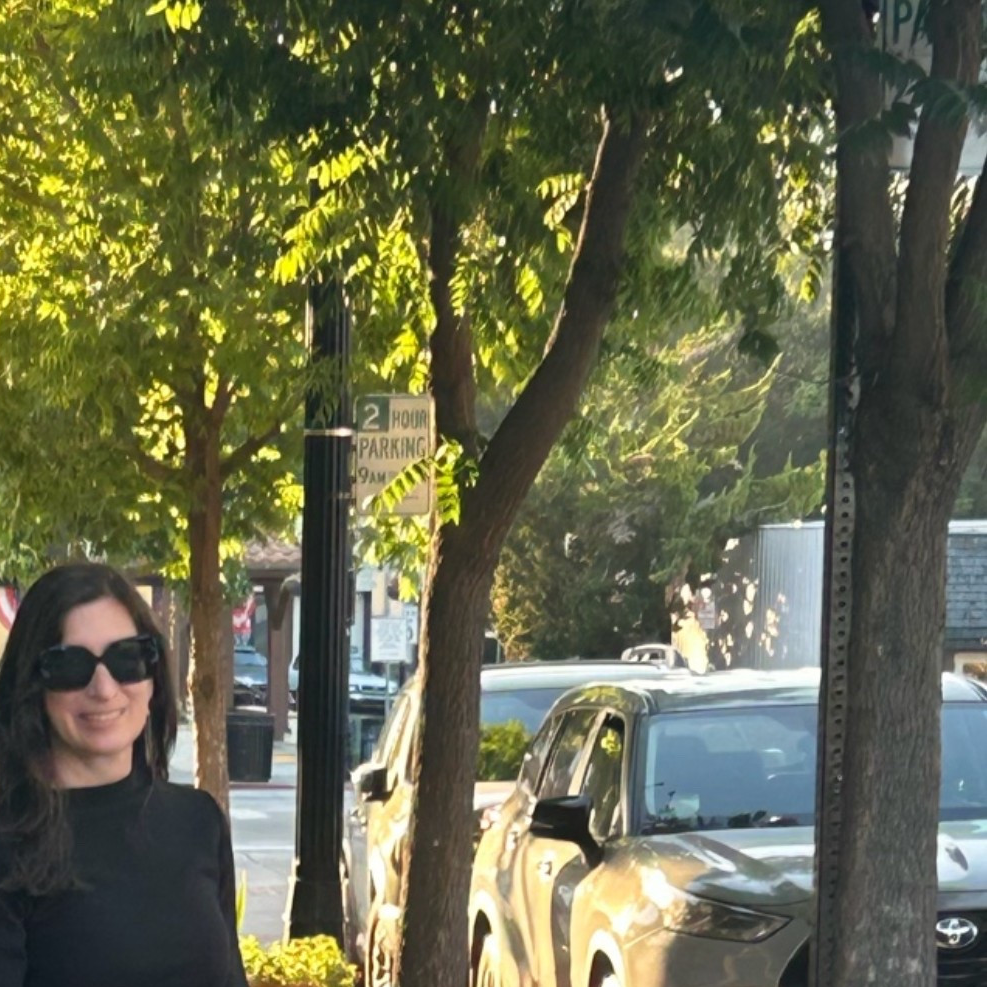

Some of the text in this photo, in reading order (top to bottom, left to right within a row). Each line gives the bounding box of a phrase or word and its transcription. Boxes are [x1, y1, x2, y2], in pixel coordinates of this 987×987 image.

[363, 403, 427, 430] 2 HOUR
[359, 436, 426, 460] PARKING
